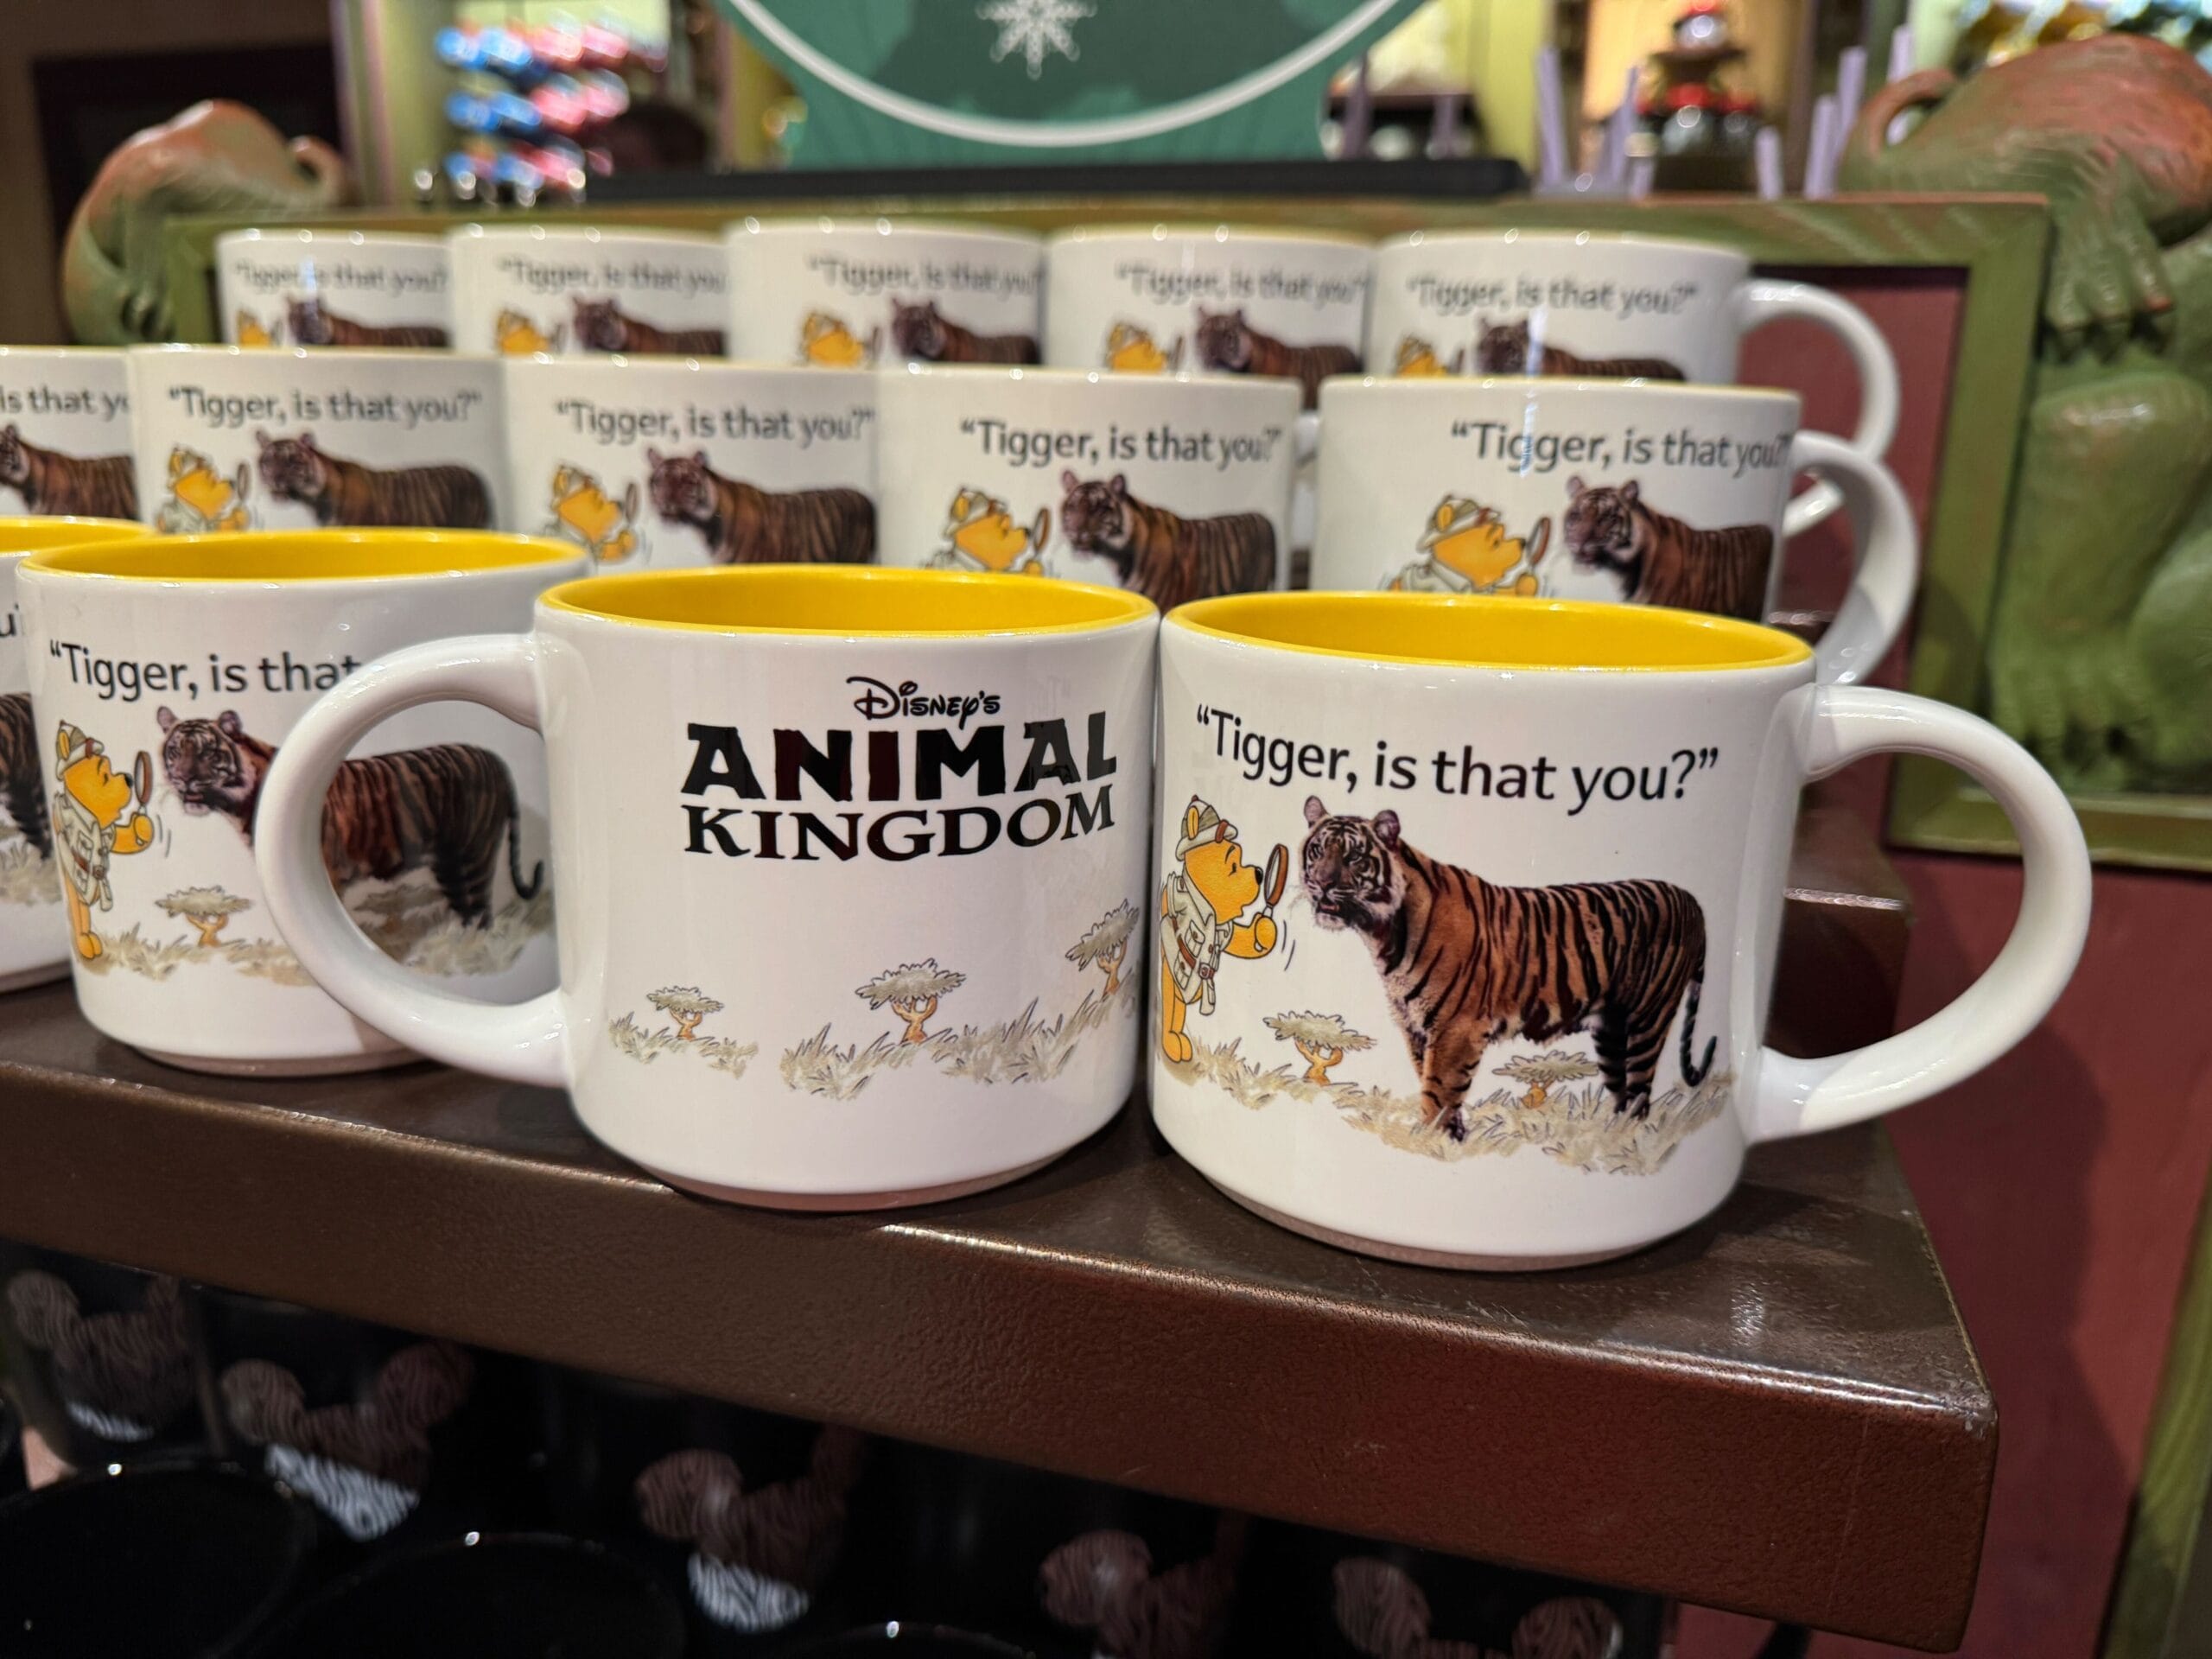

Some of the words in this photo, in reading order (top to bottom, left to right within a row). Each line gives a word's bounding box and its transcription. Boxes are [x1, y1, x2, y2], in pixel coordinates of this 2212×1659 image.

[1516, 272, 1541, 308] is
[1548, 272, 1612, 311] that
[27, 385, 97, 413] that
[294, 391, 322, 419] is
[328, 391, 399, 421] that
[690, 405, 716, 438] is
[722, 404, 794, 441] that
[1109, 426, 1136, 460] is
[1145, 426, 1210, 462] that
[1623, 428, 1651, 463] is
[1662, 429, 1728, 466] that
[210, 654, 247, 691] is
[259, 652, 362, 691] that
[680, 711, 1117, 802] ANIMAL
[1374, 741, 1417, 791] is
[1432, 745, 1556, 800] that
[680, 784, 1116, 861] KINGDOM
